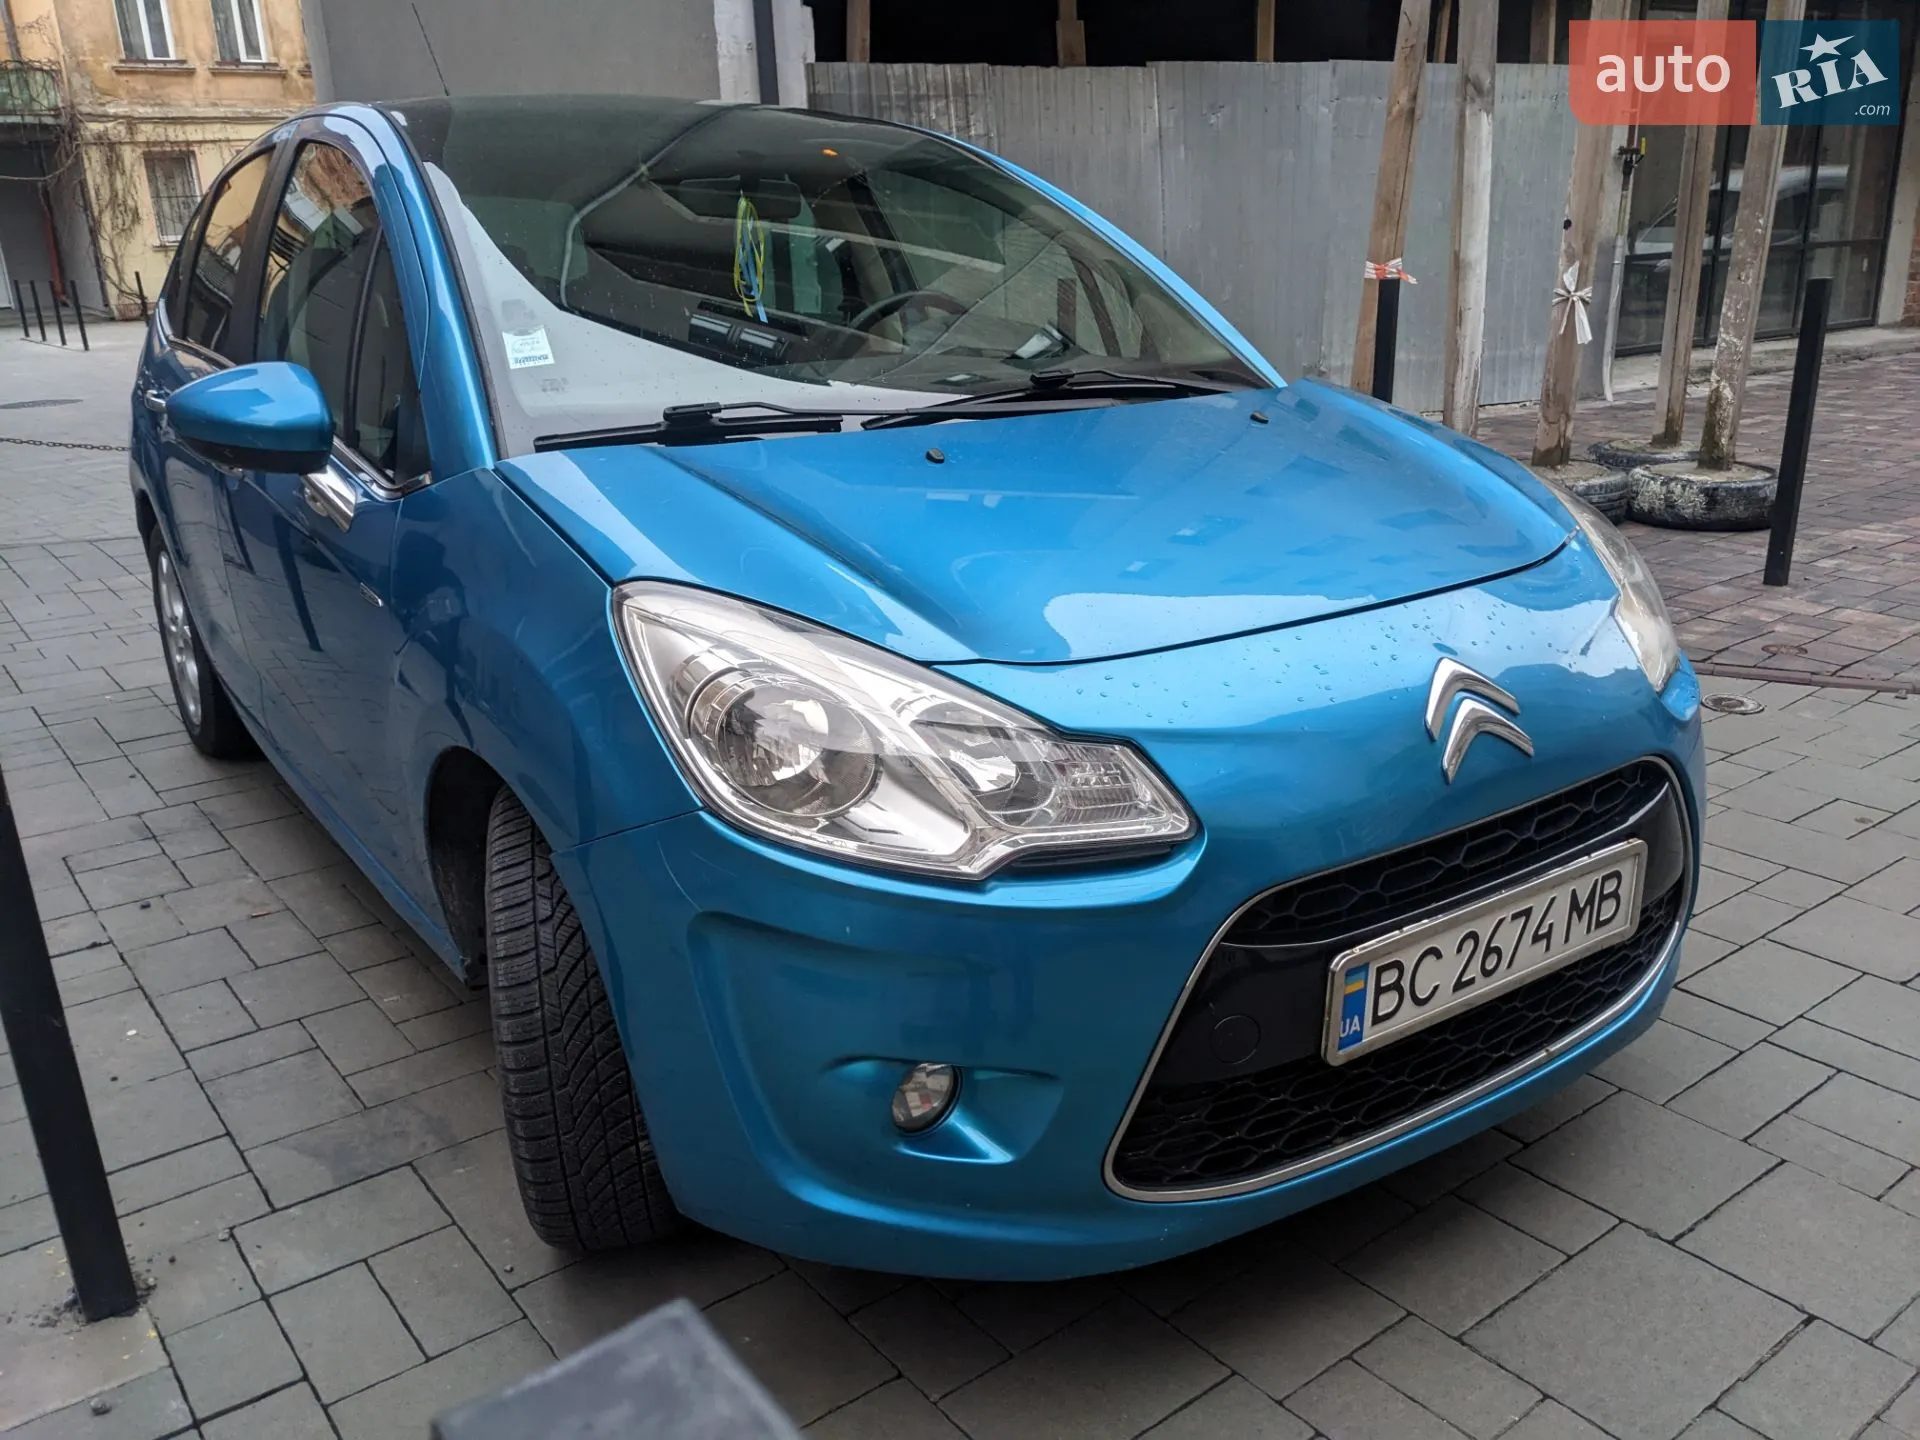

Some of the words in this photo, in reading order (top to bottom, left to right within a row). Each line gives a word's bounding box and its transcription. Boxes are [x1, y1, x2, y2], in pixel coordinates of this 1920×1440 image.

[1370, 946, 1443, 1027] BC
[1451, 896, 1557, 996] 2674
[1563, 869, 1623, 945] MB
[1340, 1014, 1361, 1038] UA
